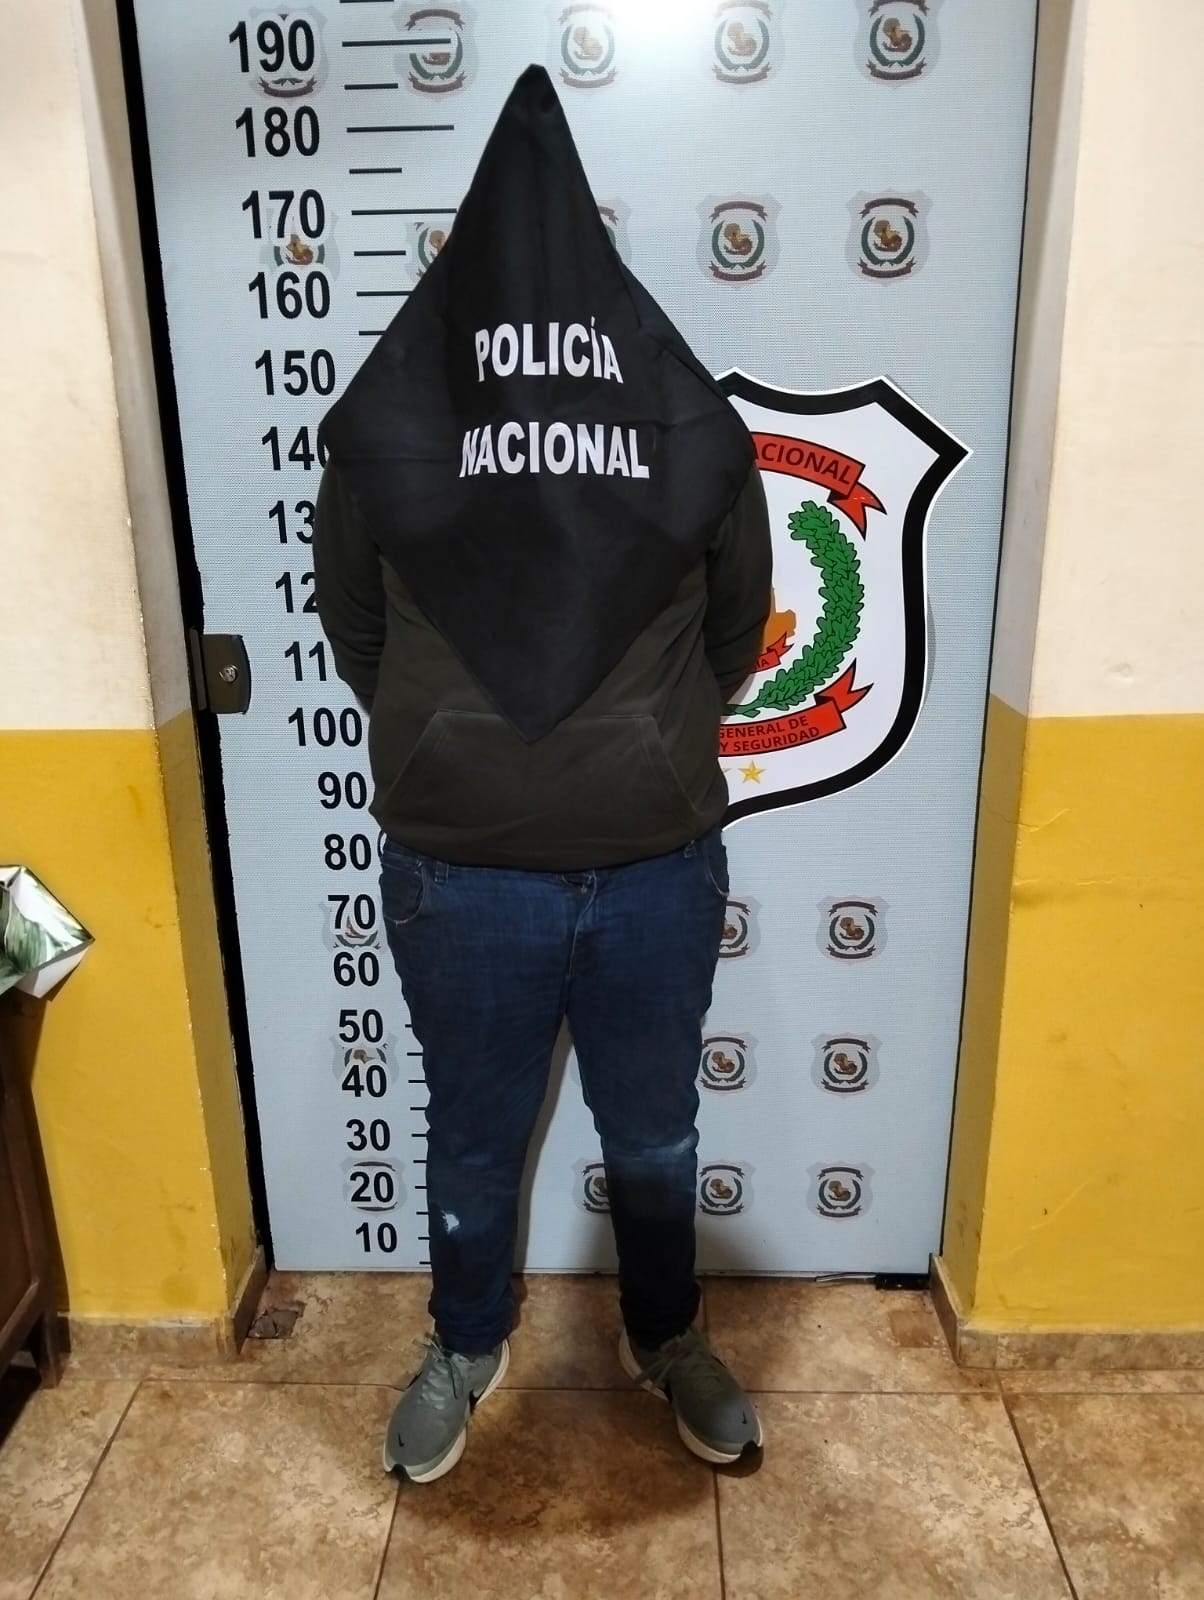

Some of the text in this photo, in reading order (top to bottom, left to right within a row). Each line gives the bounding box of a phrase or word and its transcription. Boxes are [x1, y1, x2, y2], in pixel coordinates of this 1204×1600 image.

[229, 19, 315, 72] 190
[235, 106, 320, 157] 180
[242, 189, 325, 239] 170
[249, 271, 330, 319] 160
[475, 316, 624, 383] POLICÍA
[255, 349, 336, 396] 150
[459, 421, 650, 478] NACIONAL
[756, 443, 850, 485] CIONAL
[268, 500, 315, 544] 13
[275, 571, 319, 613] 12
[284, 641, 327, 681] 11
[288, 707, 362, 747] 100
[719, 727, 820, 752] Y SEGURIDAD
[788, 716, 809, 730] DE
[318, 772, 367, 809] 90
[324, 833, 372, 871] 80
[327, 894, 376, 930] 70
[333, 951, 380, 987] 60
[338, 1009, 384, 1043] 50
[341, 1065, 388, 1098] 40
[346, 1119, 391, 1151] 30
[350, 1171, 394, 1203] 20
[355, 1222, 398, 1253] 10
